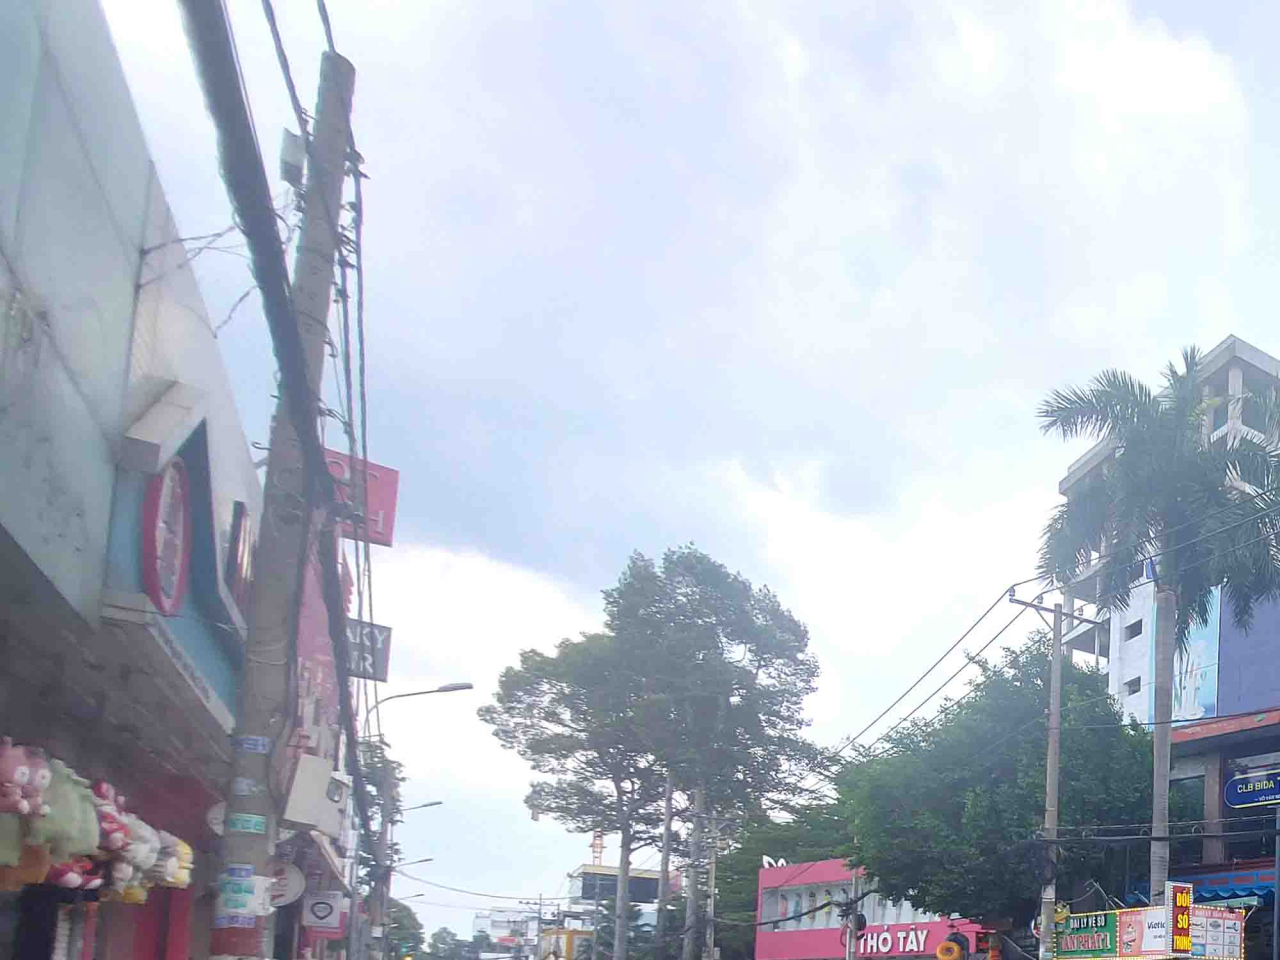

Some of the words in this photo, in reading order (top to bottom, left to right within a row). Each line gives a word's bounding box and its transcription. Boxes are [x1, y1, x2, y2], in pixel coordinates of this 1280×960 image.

[1237, 783, 1253, 793] CLB
[1255, 781, 1274, 791] BIDA
[1178, 910, 1189, 929] SỐ
[897, 925, 929, 953] TÂY
